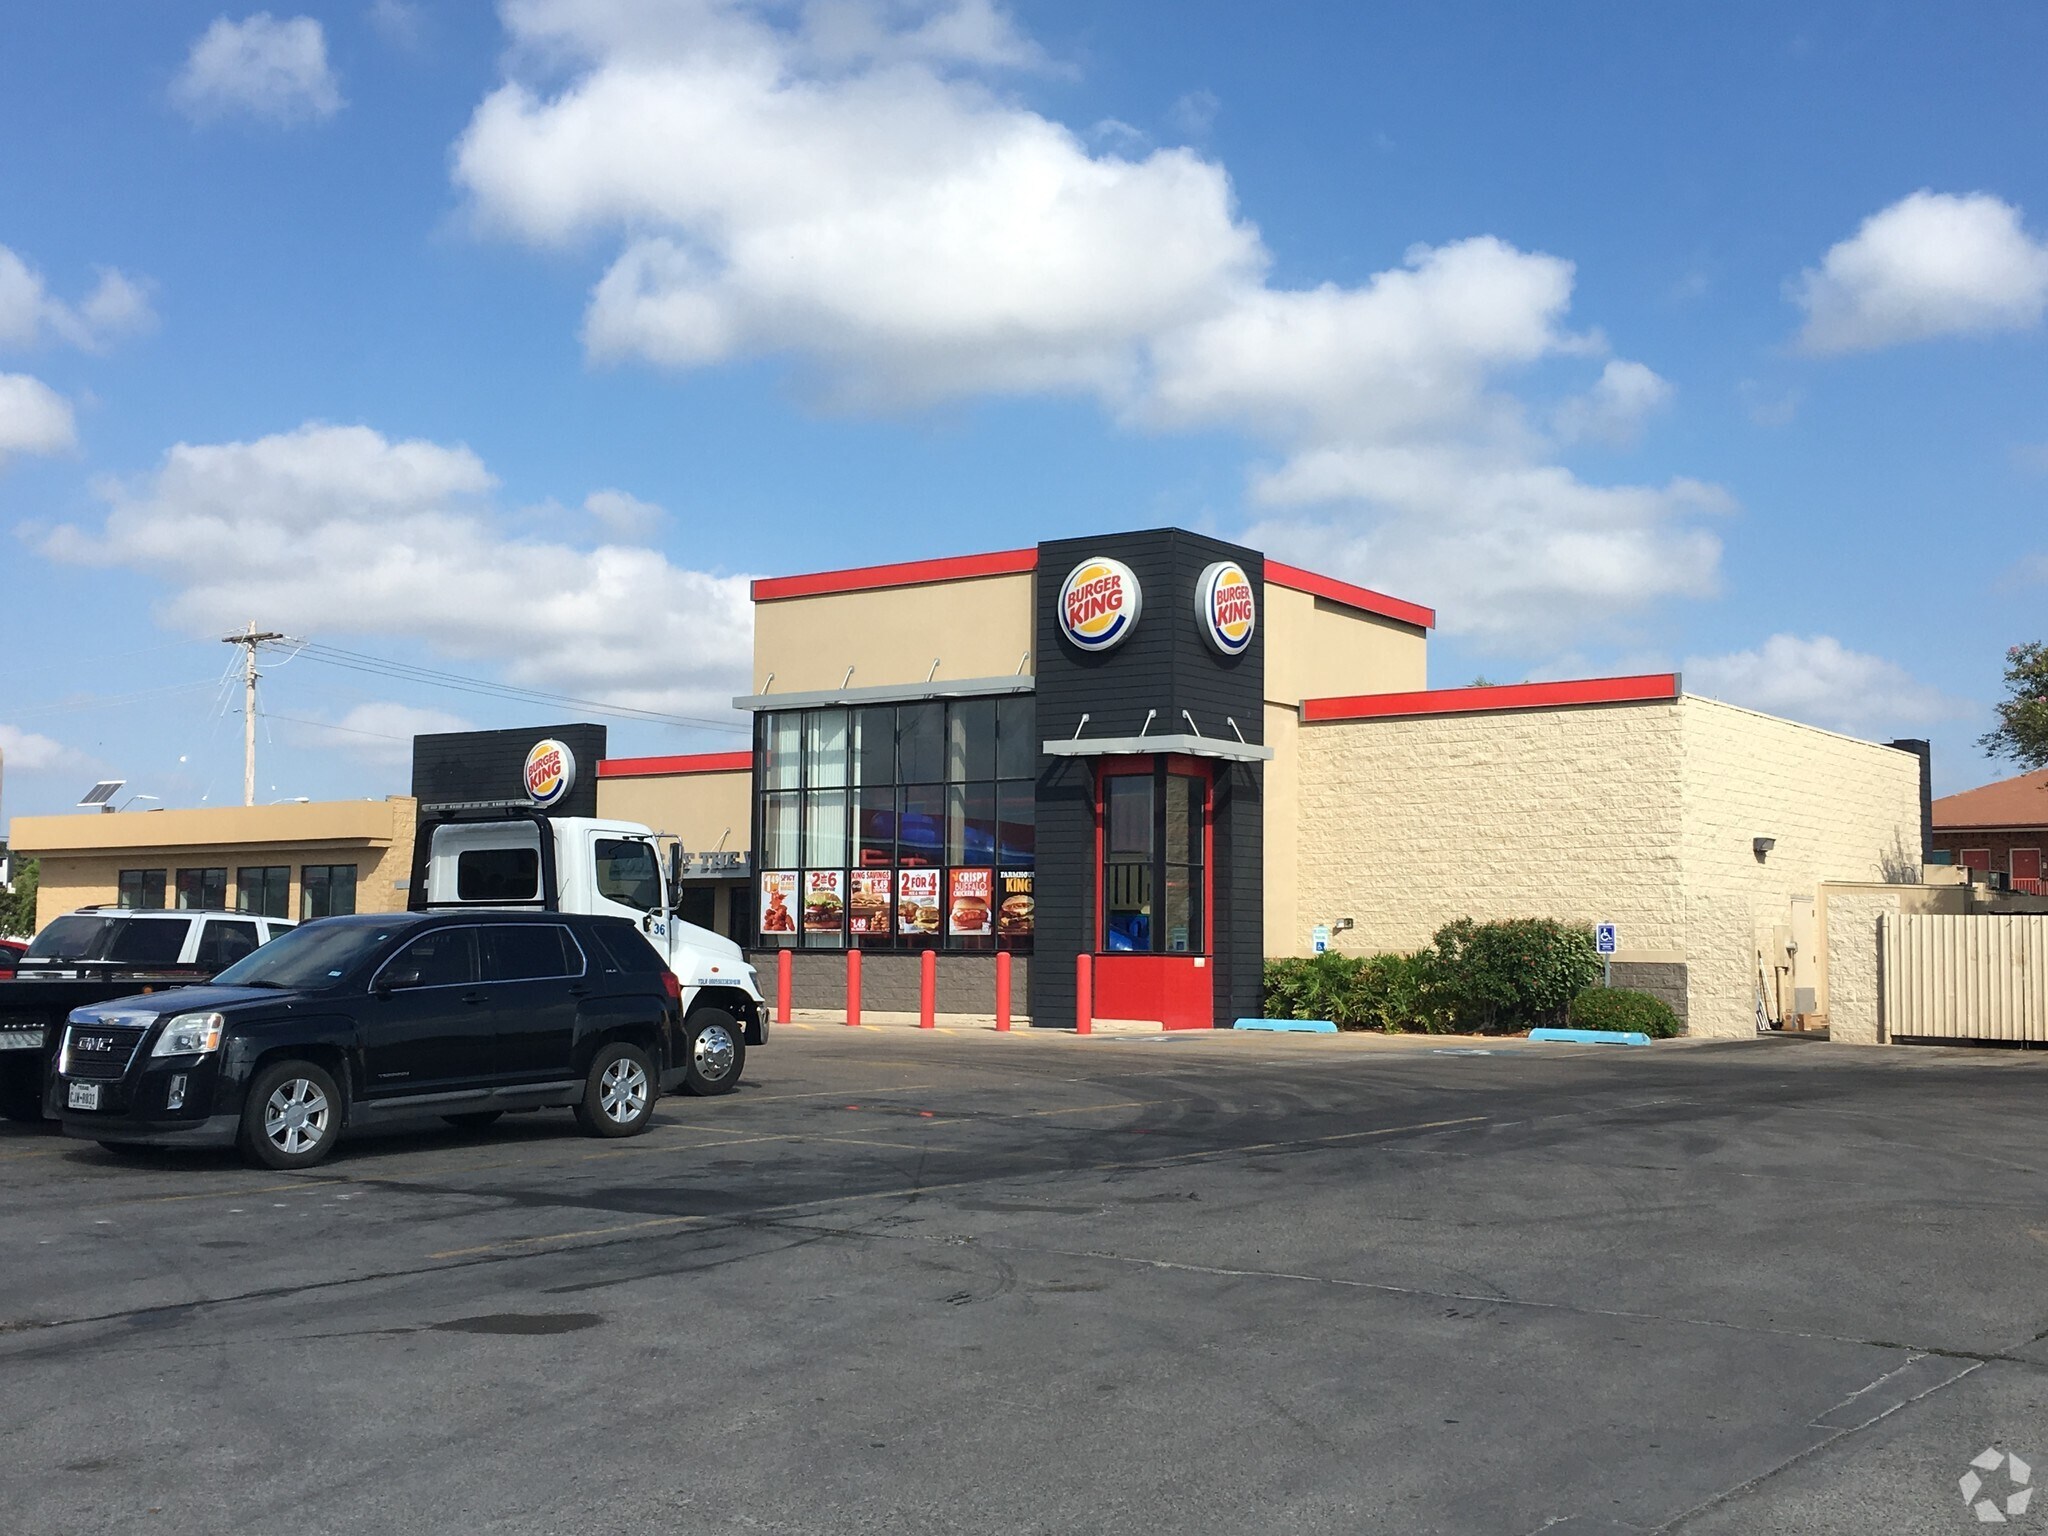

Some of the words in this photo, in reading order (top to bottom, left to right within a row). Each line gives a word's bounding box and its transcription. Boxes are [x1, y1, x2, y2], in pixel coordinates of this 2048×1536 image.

[1067, 575, 1122, 608] BURGER
[1216, 585, 1250, 606] BURGER
[1069, 589, 1123, 630] KING
[1216, 600, 1251, 628] KING
[528, 750, 560, 776] BURGER
[529, 760, 561, 792] KING
[699, 852, 739, 869] THE
[866, 870, 889, 879] SAVINGS
[901, 872, 910, 890] 2
[911, 876, 926, 888] FOR
[958, 872, 988, 882] CRISPY
[954, 882, 987, 891] BUFFALO
[1006, 878, 1032, 892] KING
[653, 923, 665, 935] 36
[77, 1036, 113, 1052] GMC
